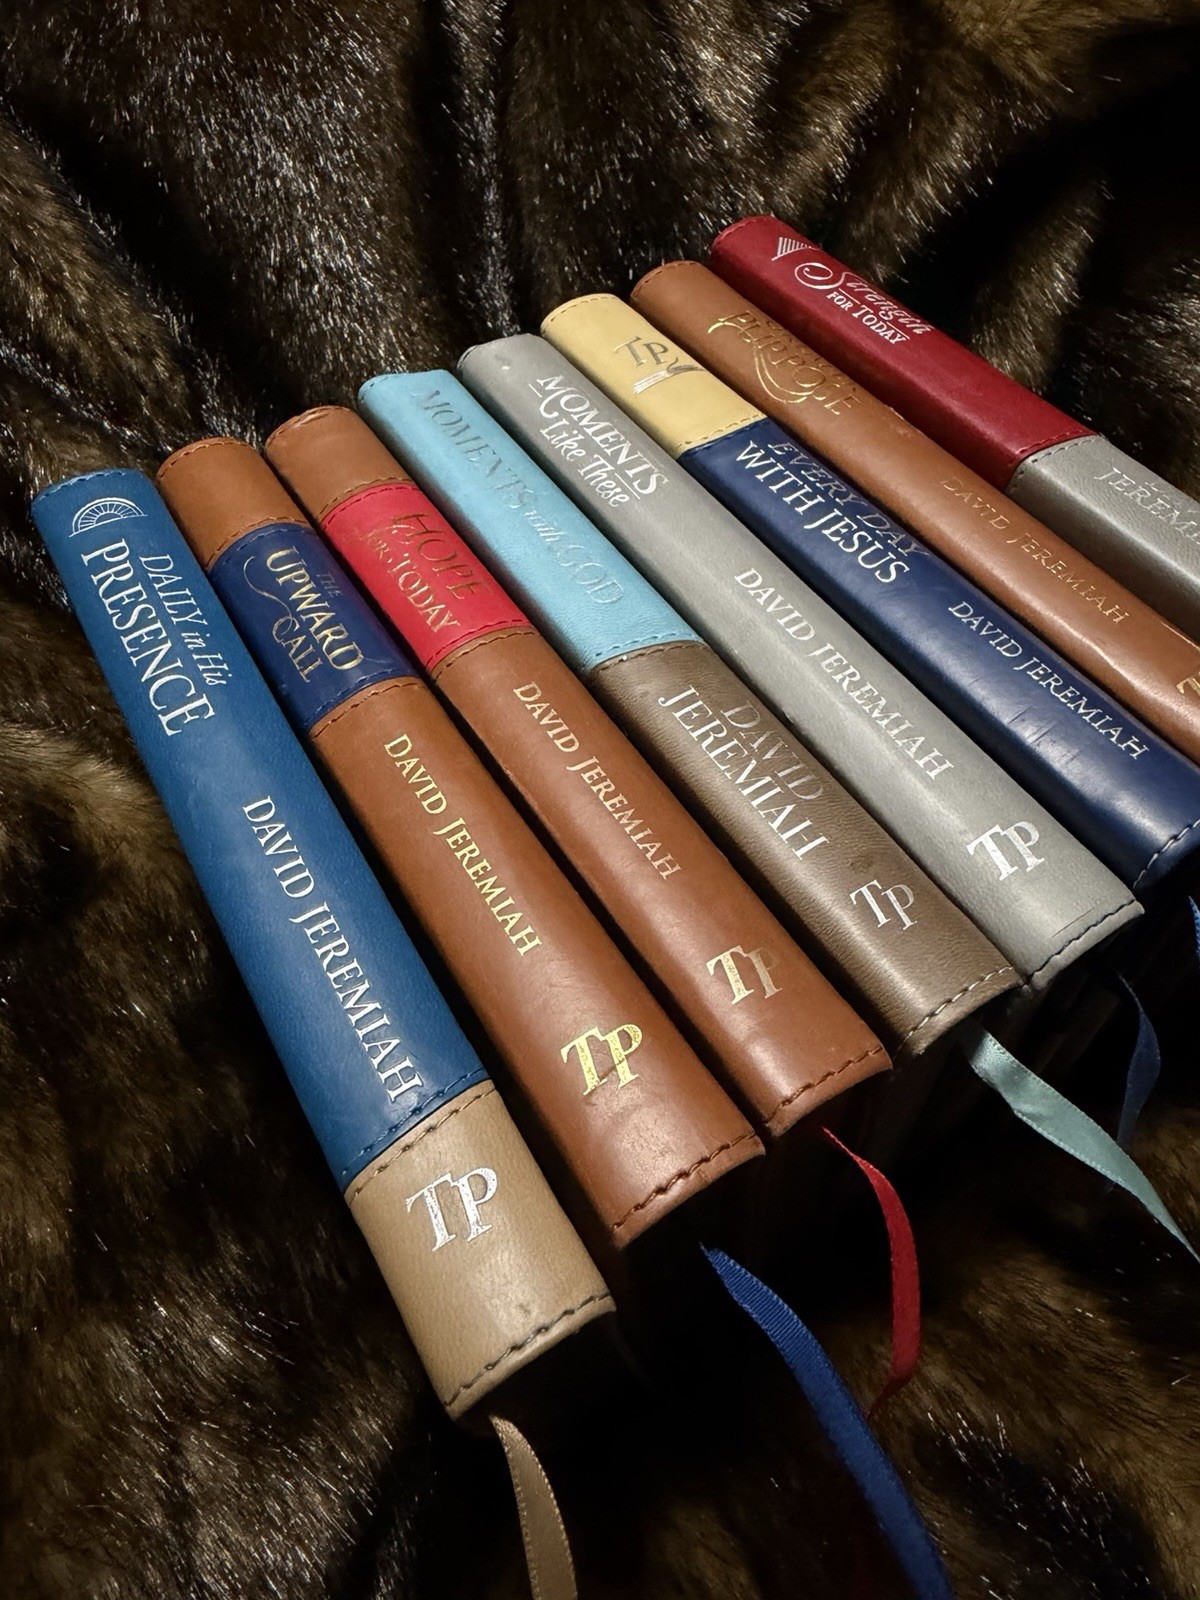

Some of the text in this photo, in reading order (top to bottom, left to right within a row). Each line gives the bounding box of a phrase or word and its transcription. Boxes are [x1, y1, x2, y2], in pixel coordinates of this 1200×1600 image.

[613, 335, 668, 367] TP
[826, 290, 907, 345] FOR TODAY
[536, 375, 669, 495] MOMENTS
[539, 418, 631, 507] Like These
[390, 512, 493, 600] HOPE
[736, 440, 911, 584] WITH JESUS
[767, 442, 933, 557] EVERY DAY
[80, 538, 216, 737] PRESENCE
[138, 553, 233, 687] DAILY in His
[265, 545, 365, 671] UPWARD
[271, 615, 324, 684] CALL
[386, 551, 462, 633] TODAY
[734, 567, 955, 780] DAVID JEREMIAH
[947, 601, 1151, 760] DAVID JEREMIAH
[512, 680, 682, 881] DAVID JEREMIAH
[657, 684, 830, 862] JEREMIAH
[719, 700, 826, 801] DAVID
[384, 733, 544, 956] DAVID JEREMIAH
[966, 820, 1046, 882] TP
[242, 795, 424, 1104] DAVID JEREMIAH
[849, 879, 918, 931] TP
[560, 1023, 644, 1097] TP
[405, 1166, 499, 1253] TP
